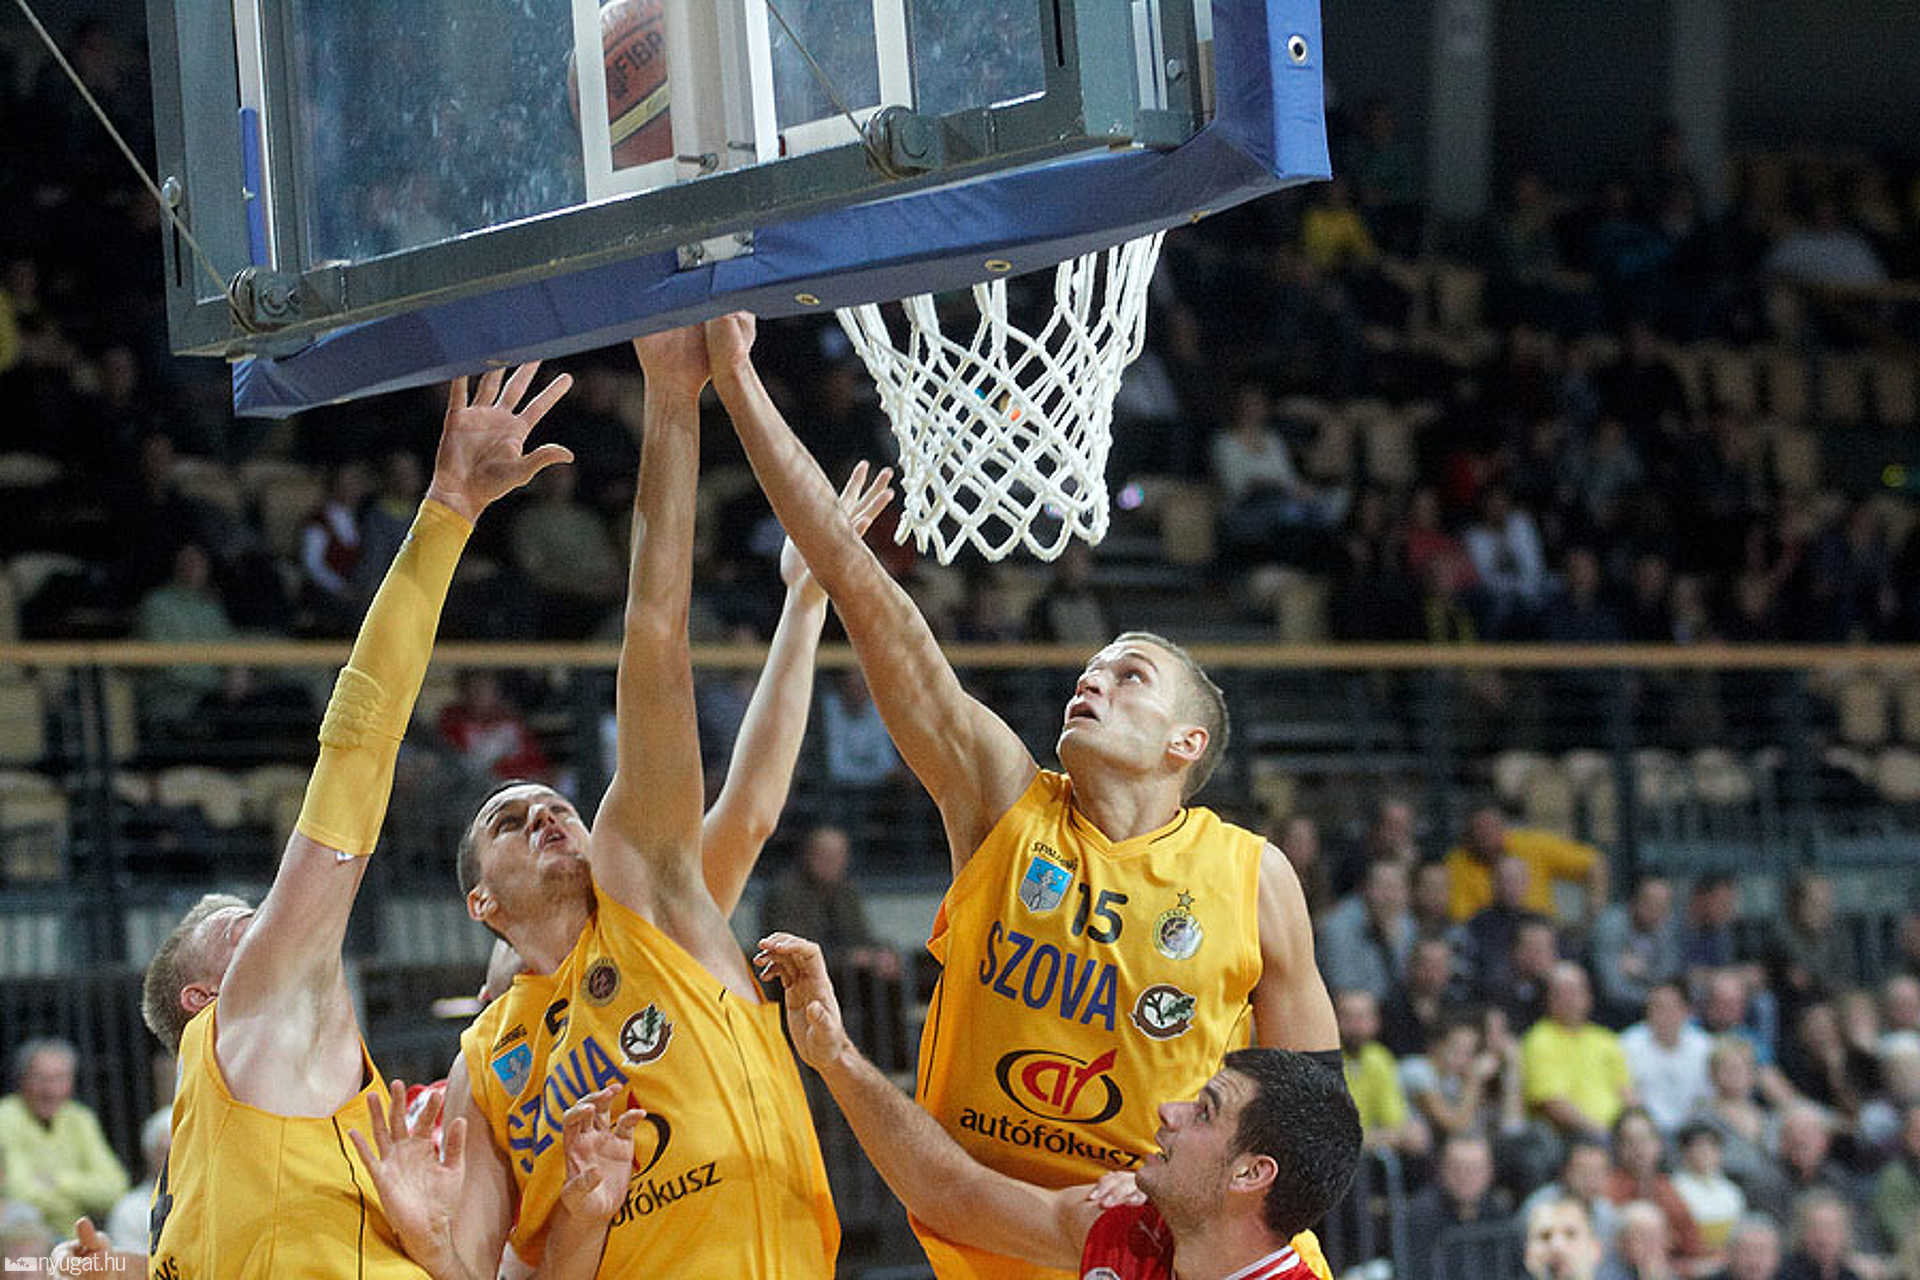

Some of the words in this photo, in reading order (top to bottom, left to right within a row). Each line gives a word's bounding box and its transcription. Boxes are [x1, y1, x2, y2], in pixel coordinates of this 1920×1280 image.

[1071, 882, 1128, 944] 15
[980, 921, 1119, 1032] SZOVA
[960, 1107, 1143, 1168] autófókusz
